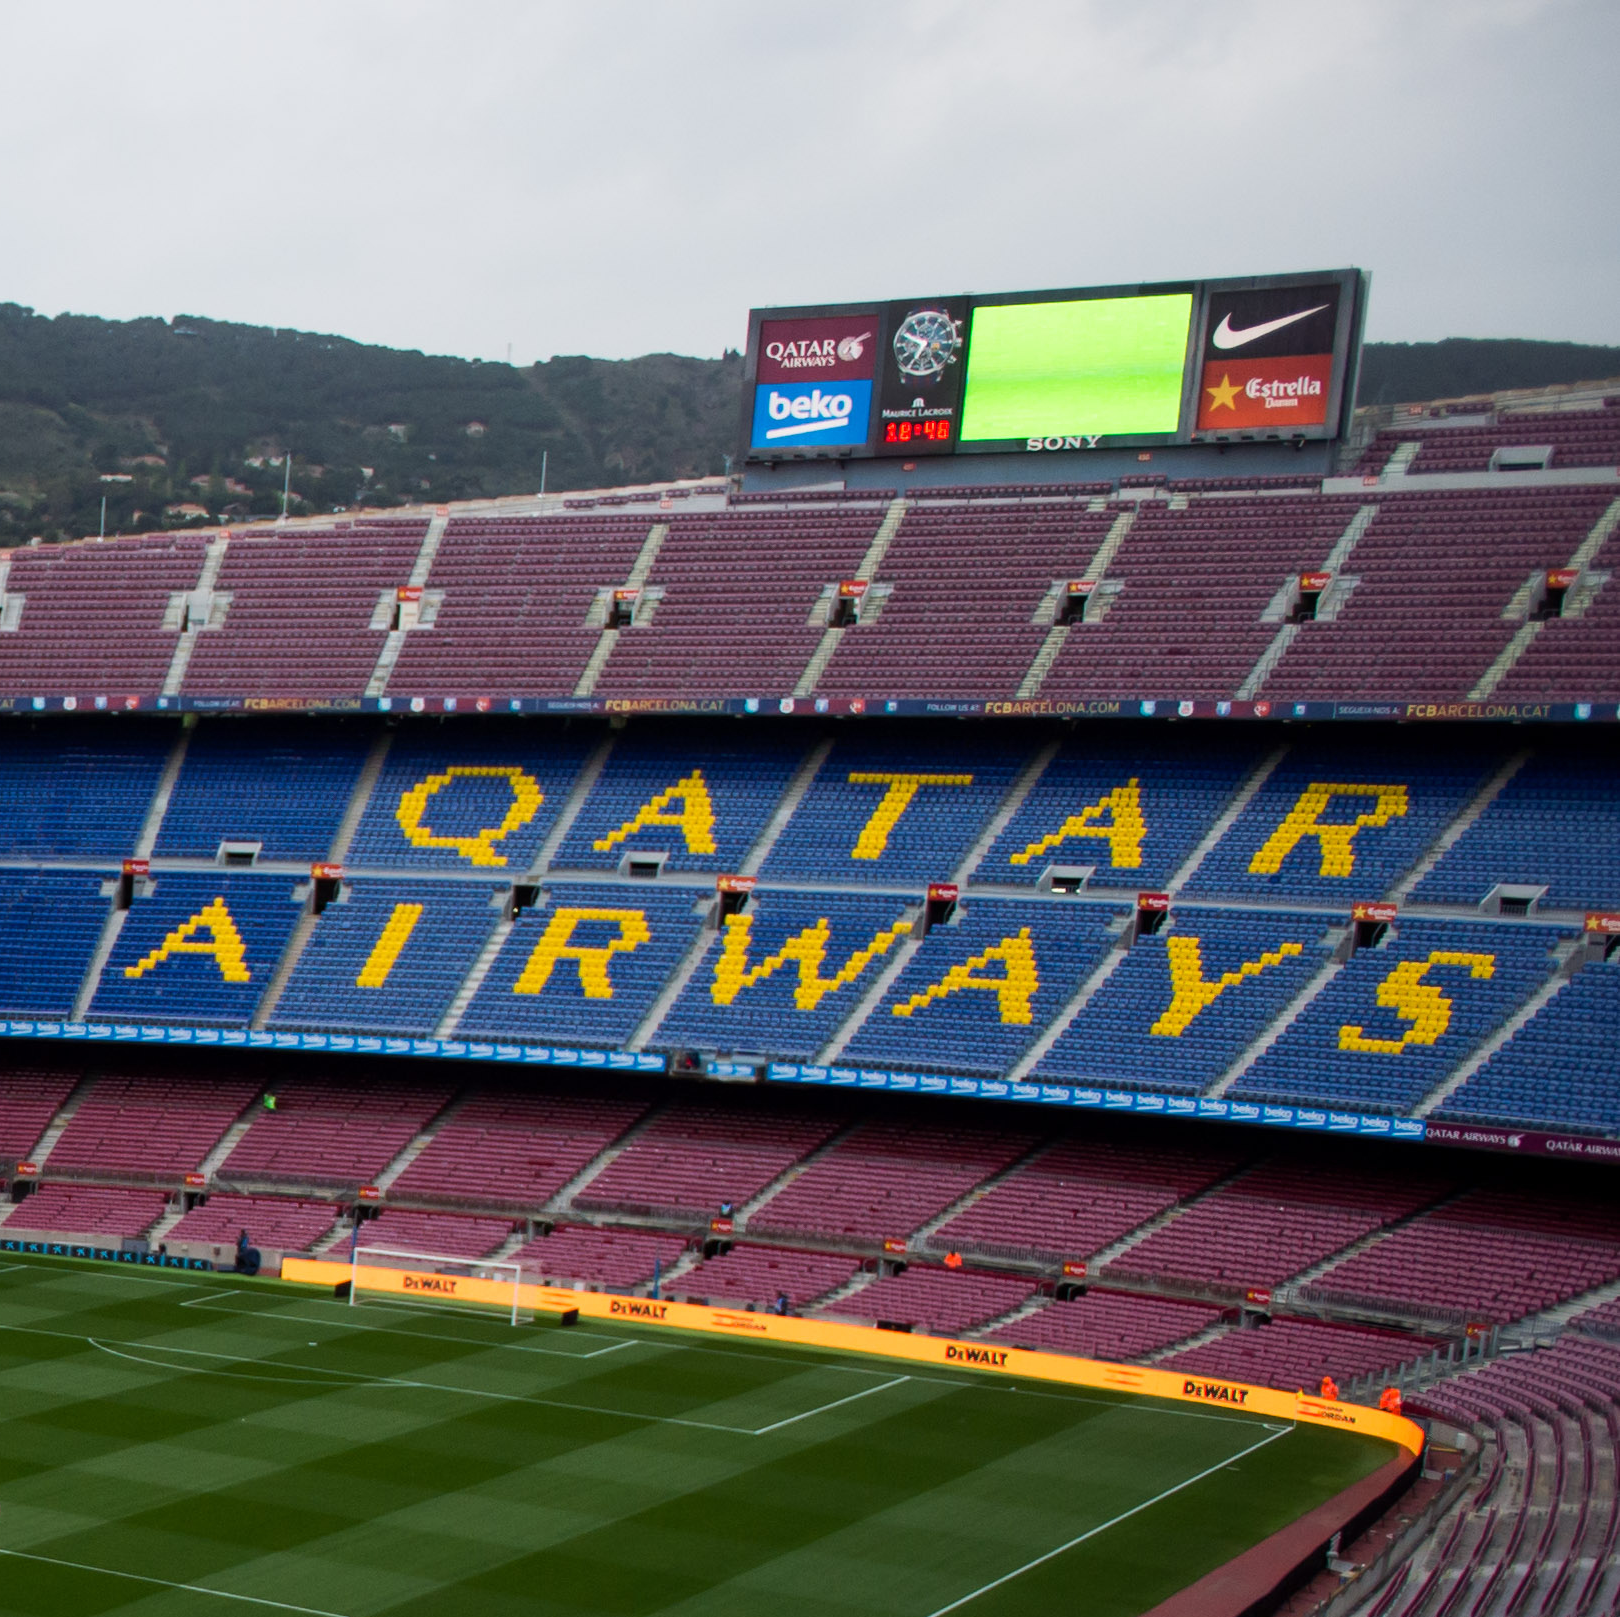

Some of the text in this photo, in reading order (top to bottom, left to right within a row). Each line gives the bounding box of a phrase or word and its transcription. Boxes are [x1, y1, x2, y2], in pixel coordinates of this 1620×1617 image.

[766, 338, 836, 362] QATAR
[780, 355, 836, 369] AIRWAYS
[1245, 376, 1322, 399] Estrella
[768, 388, 853, 421] beko
[1264, 397, 1298, 409] Damm
[882, 406, 953, 419] MAURICE LACROIX
[1026, 435, 1103, 452] SONY
[984, 701, 1120, 715] FCBARCELONA.COM
[1407, 704, 1551, 718] FCBARCELONA.CAT
[395, 764, 1409, 878] QATAR
[123, 896, 1496, 1054] AIRWAYS
[1013, 1082, 1040, 1094] beko
[1043, 1085, 1071, 1098] beko
[1075, 1088, 1102, 1101] beko
[1105, 1091, 1134, 1104] beko
[1137, 1094, 1166, 1107] beko
[1169, 1098, 1197, 1110] beko
[1201, 1101, 1229, 1113] beko
[1231, 1104, 1260, 1117] beko
[1265, 1107, 1293, 1120] beko
[1297, 1110, 1327, 1123] beko
[1329, 1114, 1359, 1126] beko
[1361, 1117, 1391, 1129] beko
[1393, 1120, 1423, 1132] beko
[1425, 1127, 1506, 1145] QATAR AIRWAYS
[1545, 1138, 1583, 1153] QATAR
